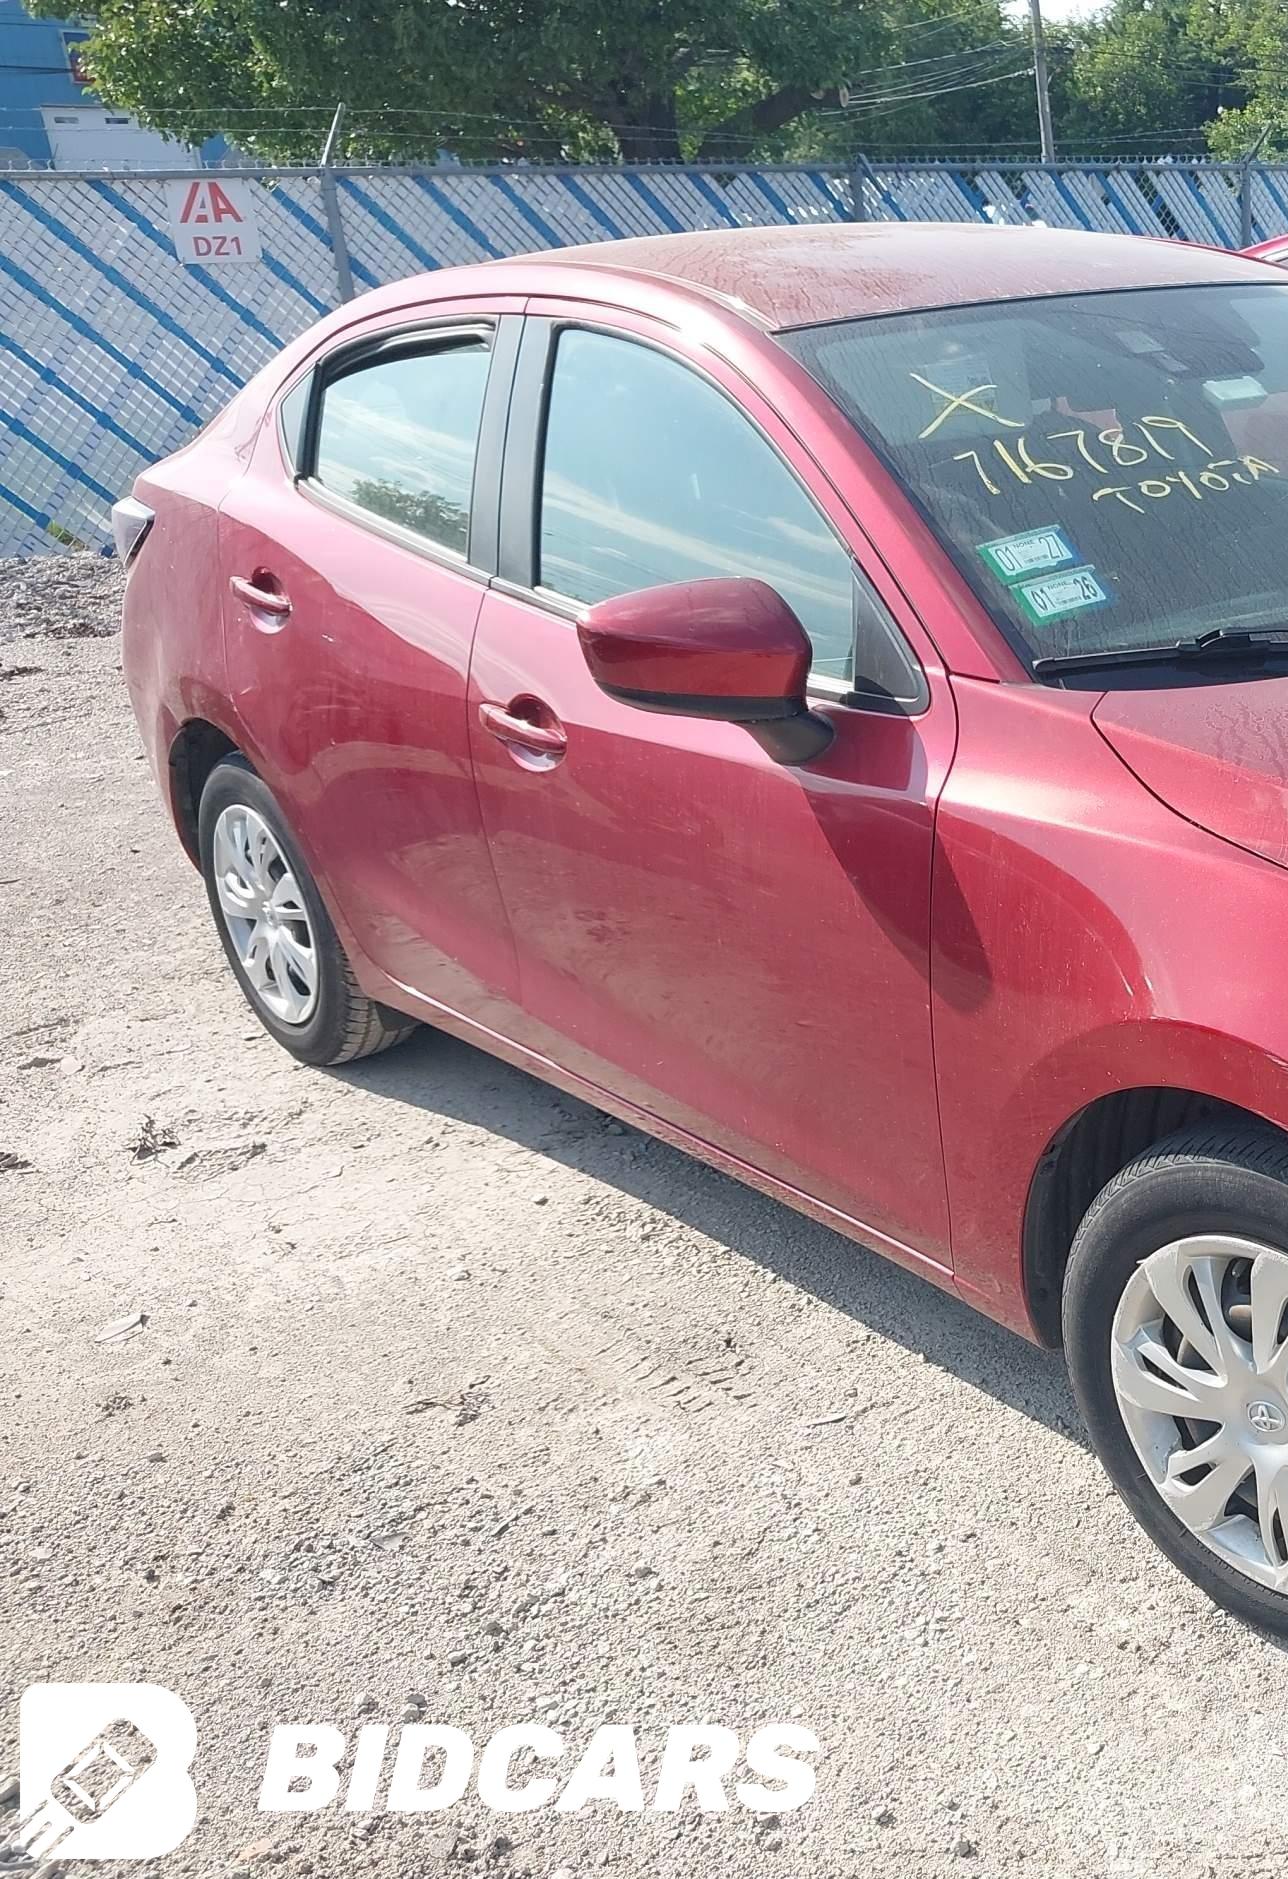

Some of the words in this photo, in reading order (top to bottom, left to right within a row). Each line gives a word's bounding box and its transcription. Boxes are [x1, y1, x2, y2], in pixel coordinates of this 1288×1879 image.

[192, 236, 242, 256] DZ1
[953, 415, 1214, 496] 7167819
[1092, 455, 1280, 514] TOYOTA
[994, 545, 1023, 572] 01
[1038, 534, 1064, 560] 27
[1031, 588, 1056, 611] 01
[1073, 575, 1098, 600] 26
